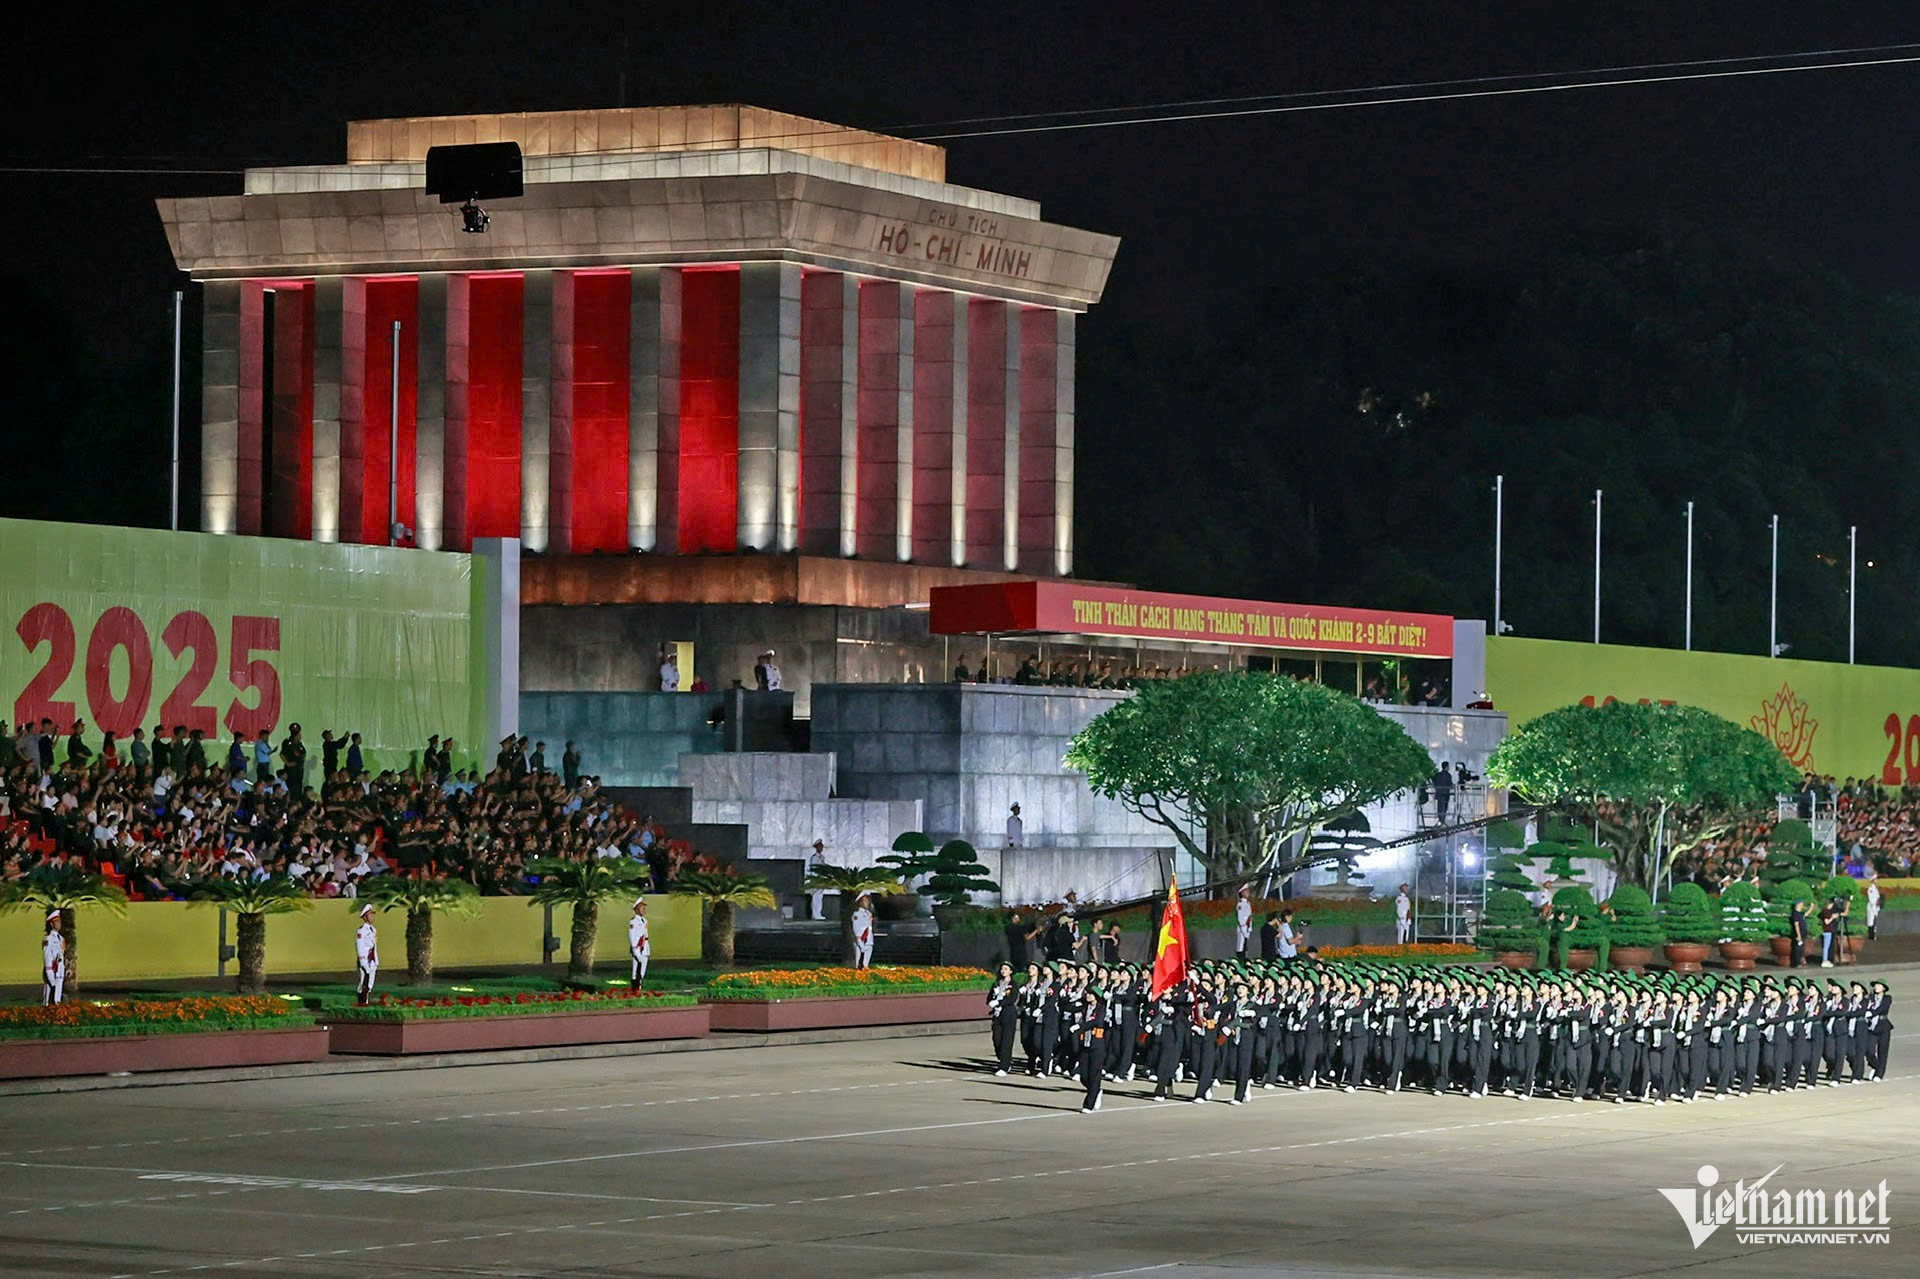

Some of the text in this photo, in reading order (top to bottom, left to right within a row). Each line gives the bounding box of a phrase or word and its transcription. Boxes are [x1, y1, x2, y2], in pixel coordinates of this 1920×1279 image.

[1072, 600, 1103, 625] TINH
[1105, 596, 1137, 627] THẦN
[1141, 601, 1170, 630] CÁCH
[1173, 608, 1205, 636] MẠNG
[1207, 608, 1244, 636] THÁNG
[1246, 609, 1271, 638] TÁM
[1272, 612, 1288, 639] VÀ
[1289, 611, 1317, 641] QUỐC
[1319, 616, 1355, 643] KHÁNH
[1356, 622, 1375, 644] 2-9
[1376, 618, 1397, 646] BẤT
[14, 602, 282, 742] 2025
